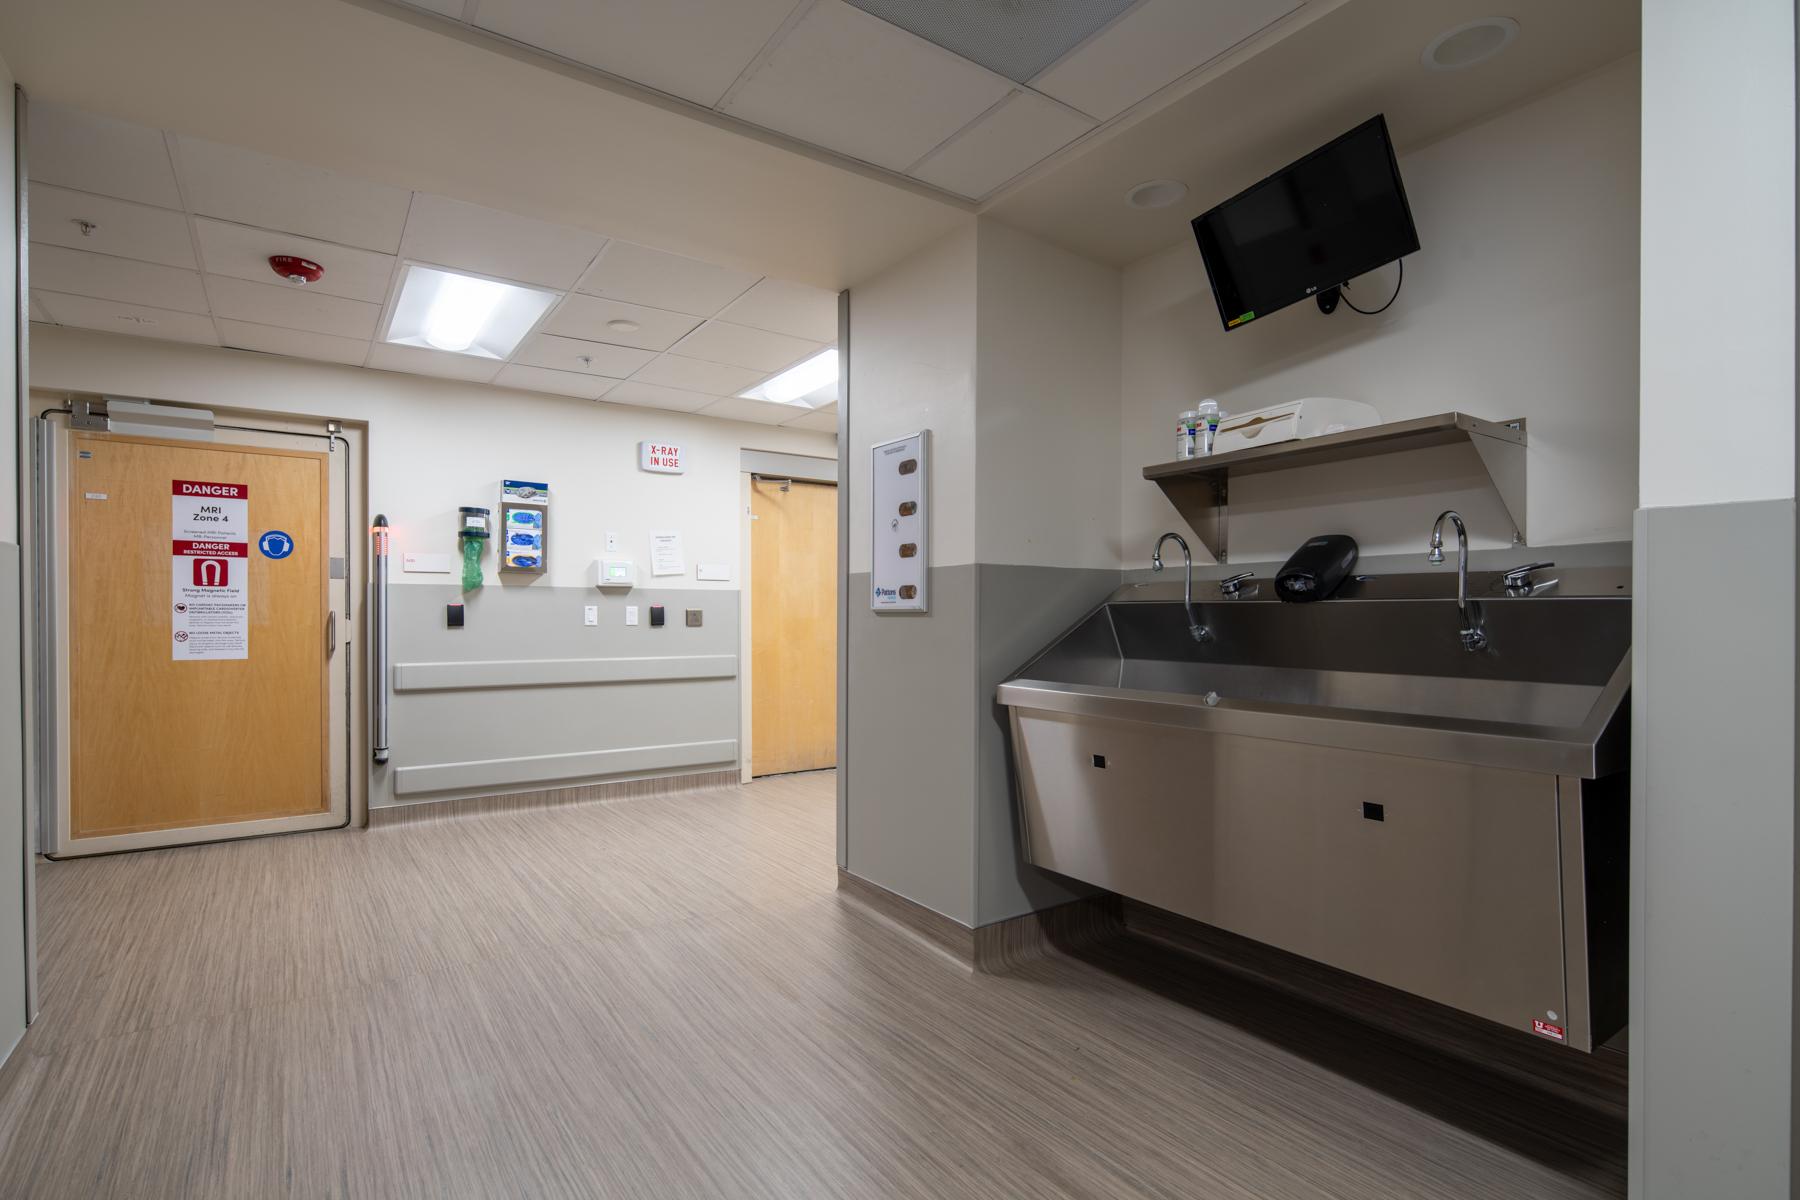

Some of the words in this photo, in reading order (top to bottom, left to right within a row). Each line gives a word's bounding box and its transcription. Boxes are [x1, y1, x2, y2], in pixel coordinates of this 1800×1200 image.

[651, 445, 679, 456] X-RAY
[650, 456, 659, 466] IN
[662, 458, 679, 468] USE
[183, 484, 238, 496] DANGER
[200, 506, 221, 514] MRI
[193, 513, 220, 522] Zone
[192, 542, 230, 550] DANGER
